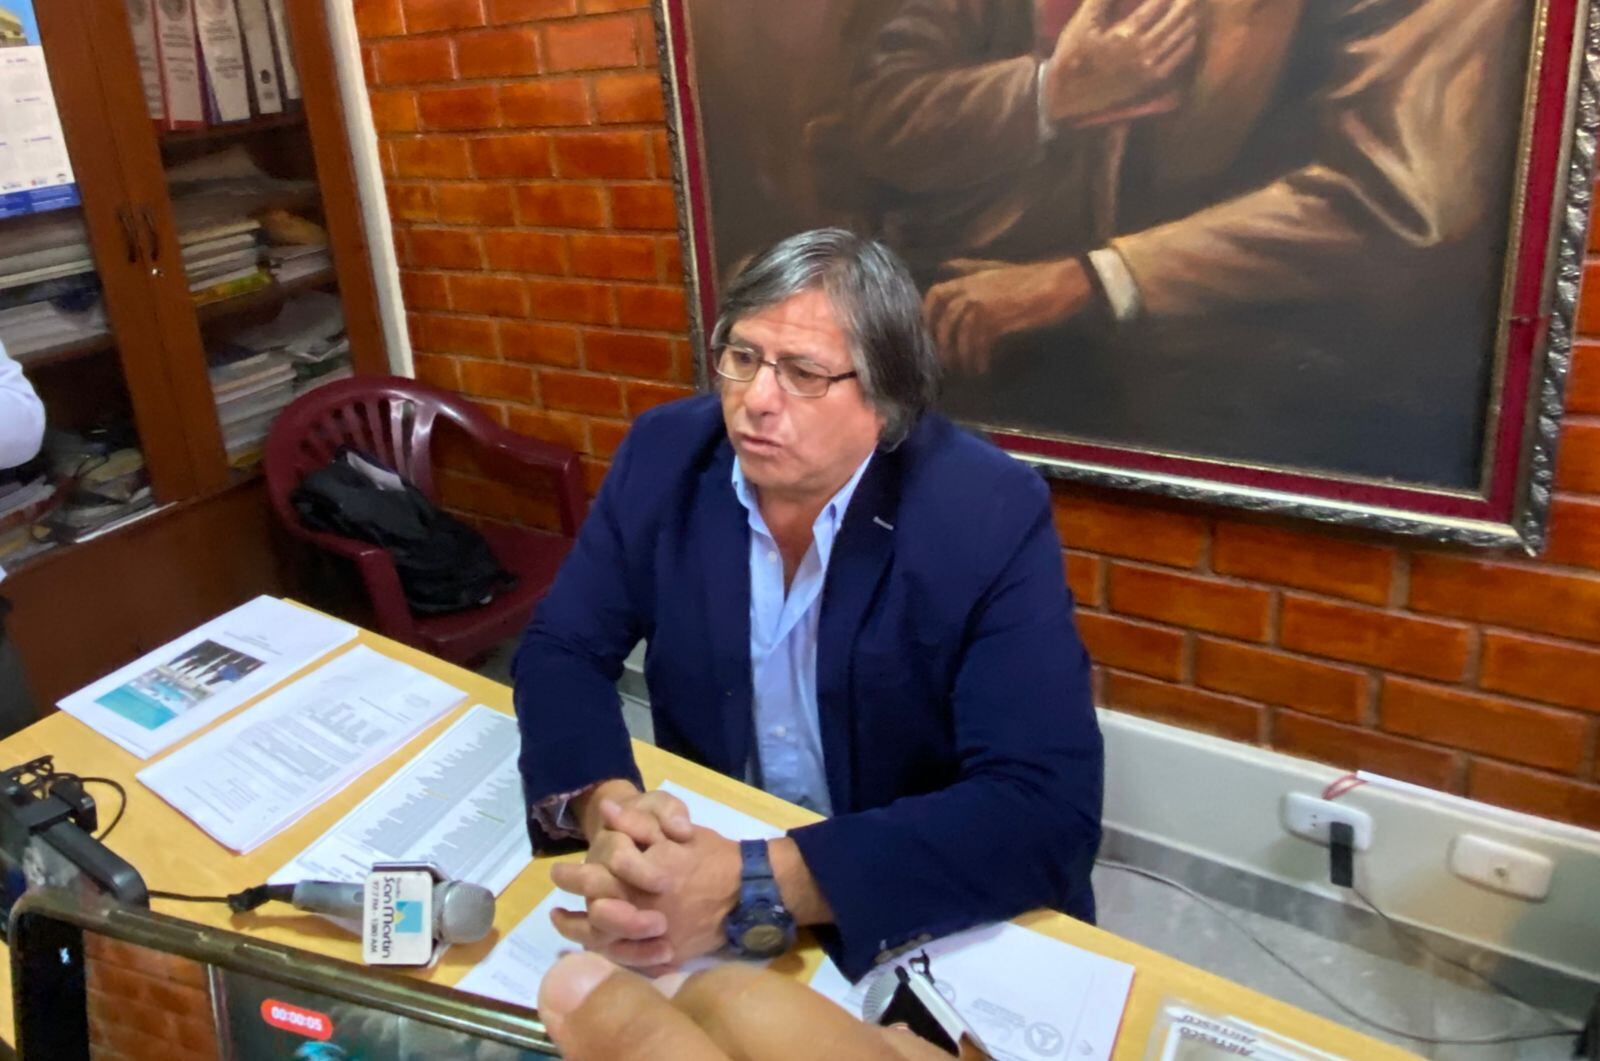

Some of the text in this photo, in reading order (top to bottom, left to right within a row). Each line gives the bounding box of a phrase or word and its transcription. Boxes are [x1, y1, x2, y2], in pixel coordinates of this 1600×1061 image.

[383, 876, 395, 904] San
[370, 938, 378, 953] AM
[271, 1006, 323, 1032] 00:00:05
